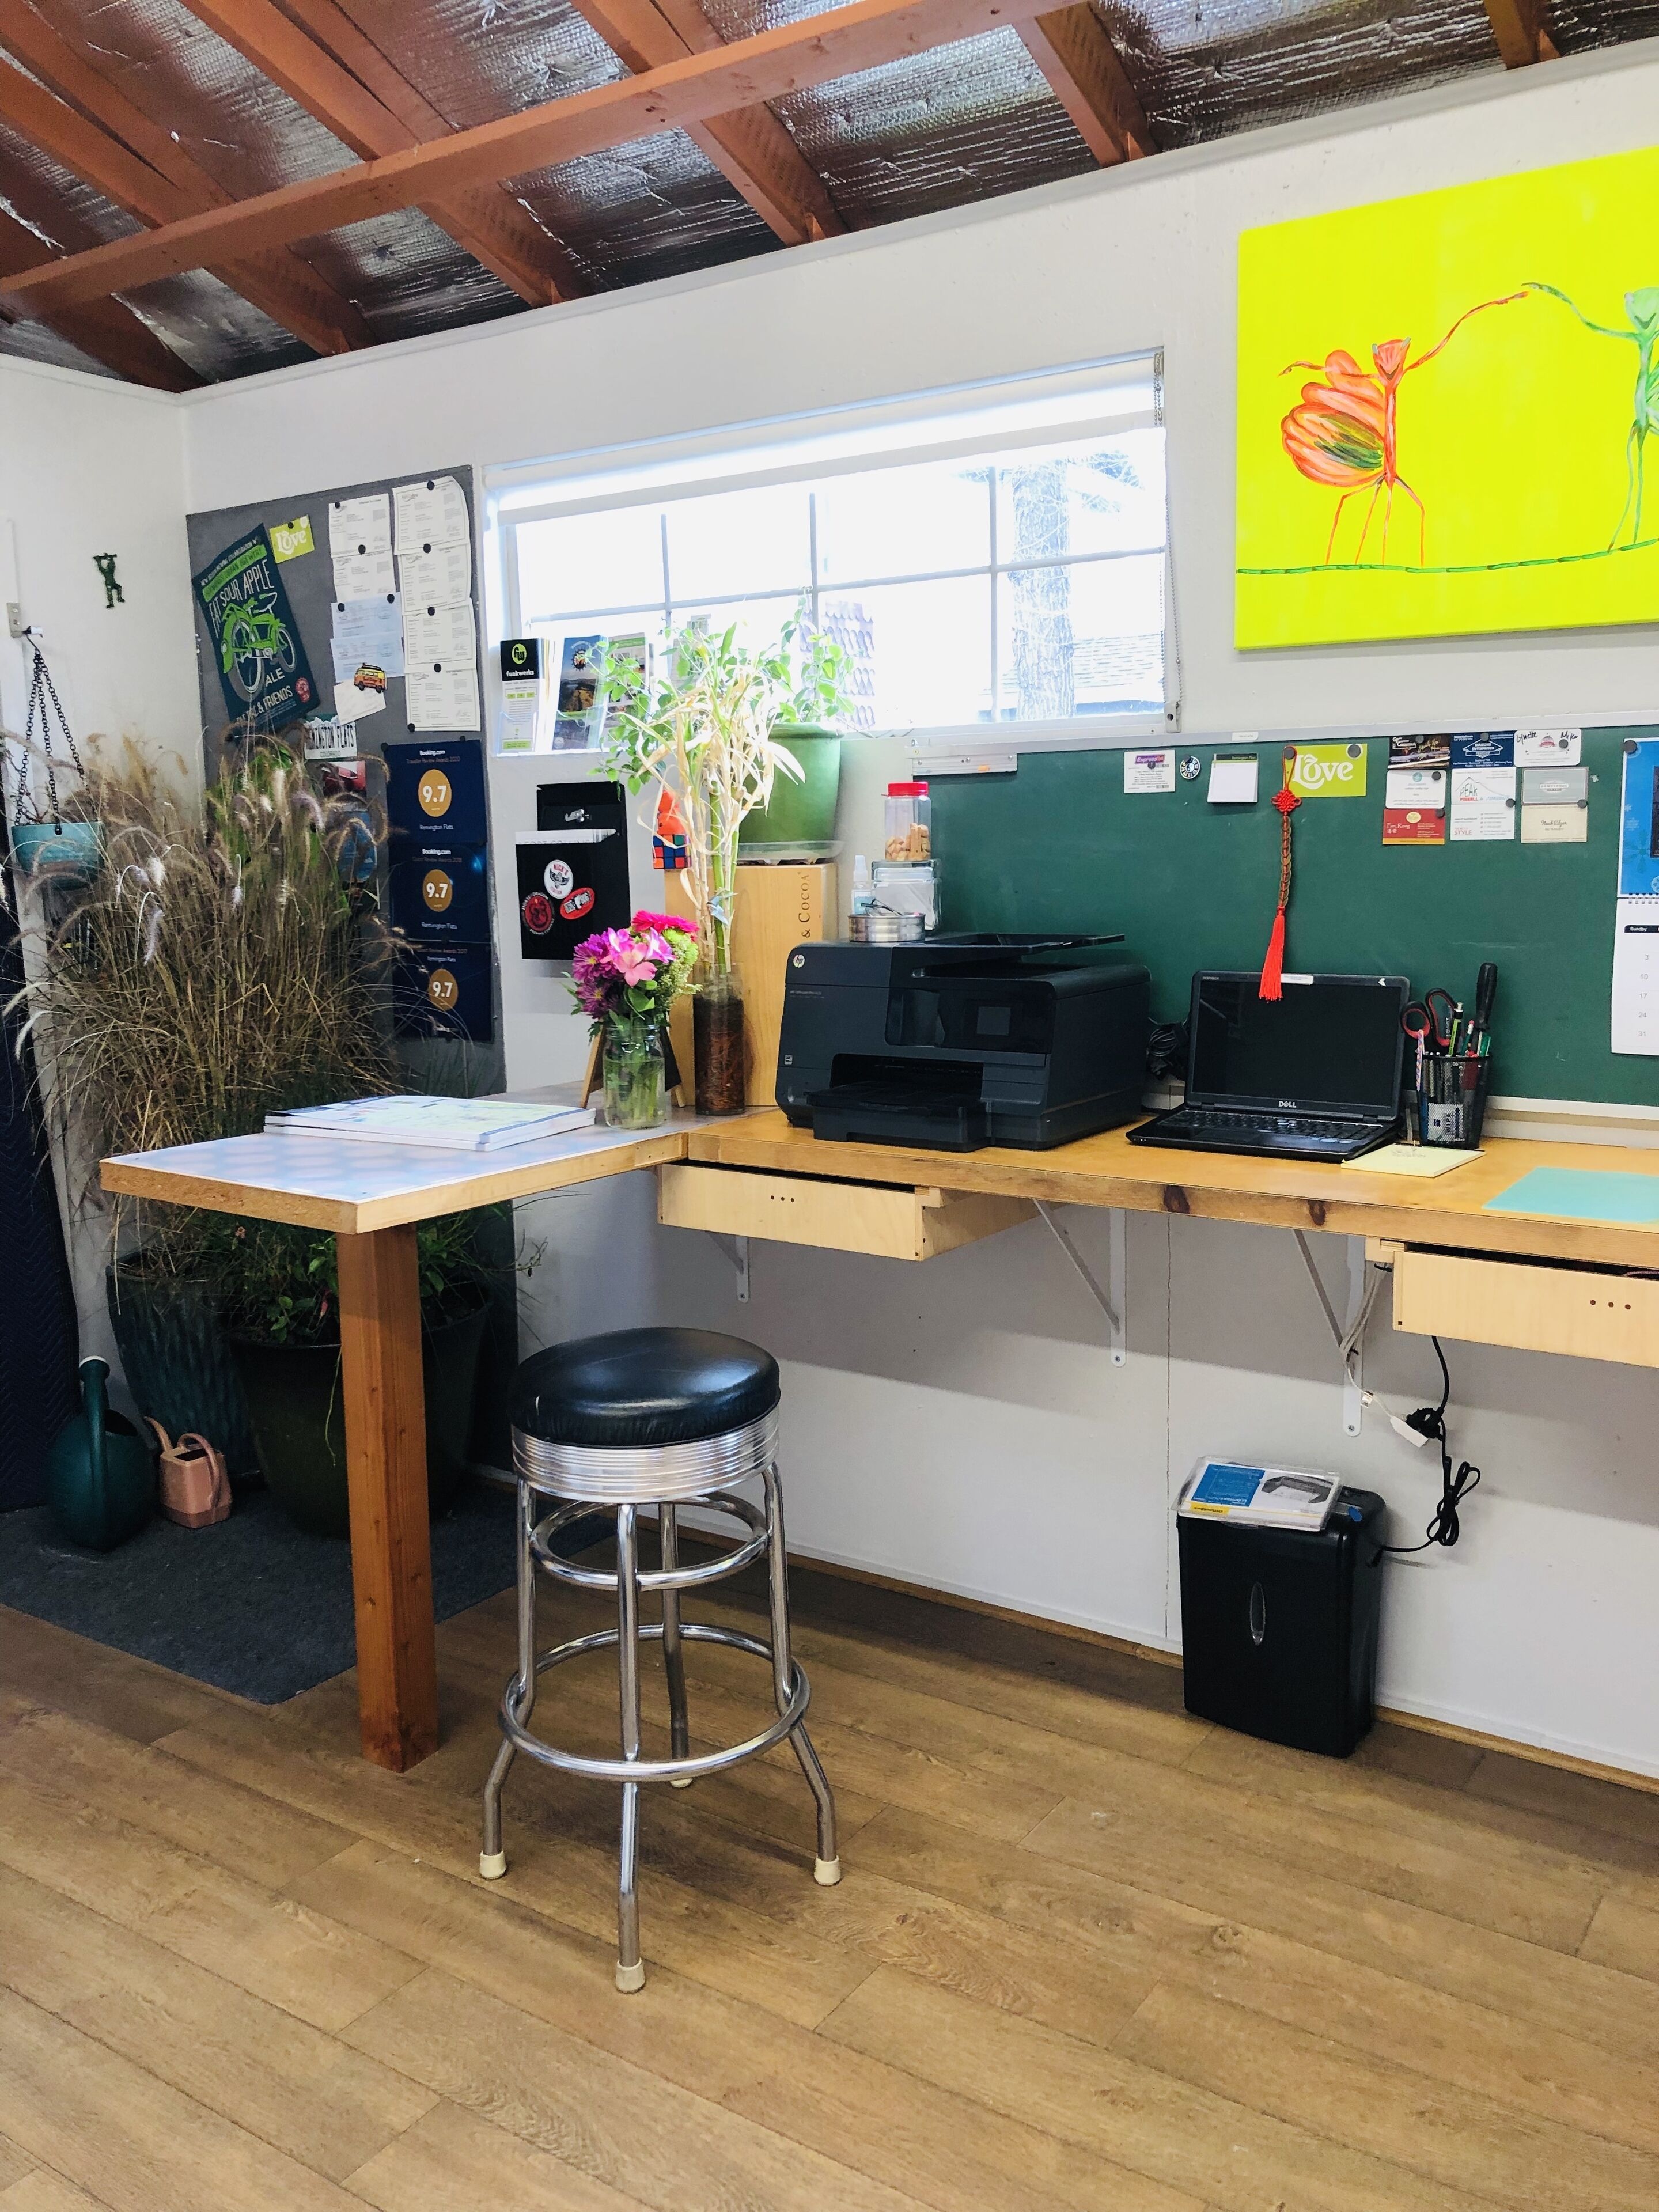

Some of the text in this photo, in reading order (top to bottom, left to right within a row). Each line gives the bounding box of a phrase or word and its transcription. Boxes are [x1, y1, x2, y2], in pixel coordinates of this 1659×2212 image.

[276, 531, 308, 555] Love
[220, 579, 243, 607] SOUR
[243, 559, 275, 599] APPLE
[266, 668, 285, 687] ALE
[506, 669, 535, 677] funkwerks
[263, 685, 293, 710] FRIENDS
[1292, 753, 1354, 790] Love
[422, 785, 448, 803] 9.7
[419, 824, 443, 832] Remington
[422, 848, 452, 856] Booking.com
[426, 882, 449, 899] 9.7
[801, 929, 810, 938] &
[795, 955, 804, 967] hp
[433, 980, 453, 998] 9.7
[1278, 1100, 1297, 1108] DELL
